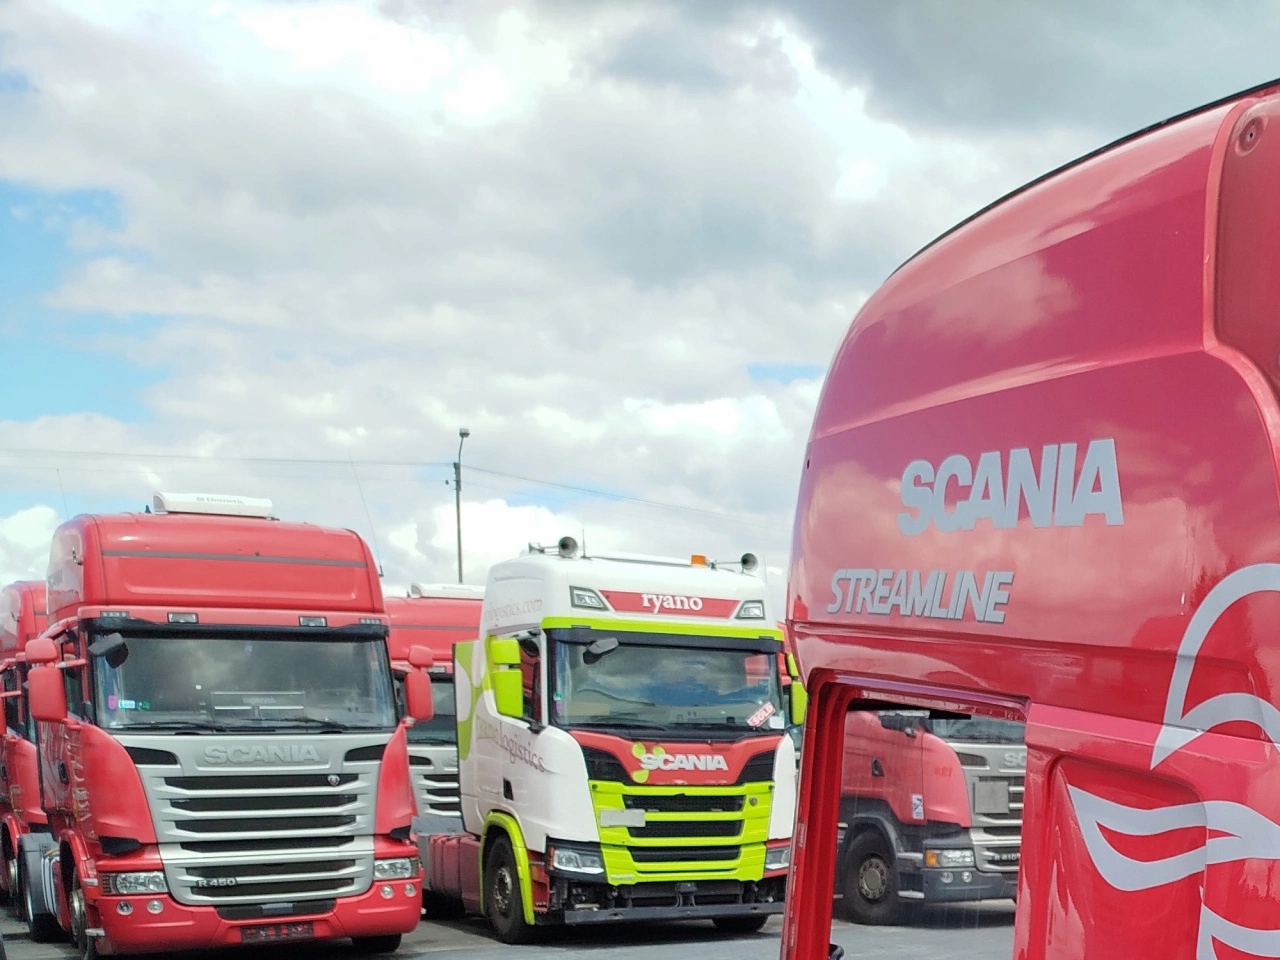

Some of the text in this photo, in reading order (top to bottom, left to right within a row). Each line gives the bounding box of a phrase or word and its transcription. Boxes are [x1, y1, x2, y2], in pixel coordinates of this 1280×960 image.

[896, 437, 1125, 536] SCANIA
[641, 593, 703, 614] ryano
[826, 568, 1014, 624] STREAMLINE
[751, 704, 775, 727] SOLD
[204, 745, 321, 765] SCANIA
[640, 753, 729, 771] SCANIA
[198, 879, 208, 888] R
